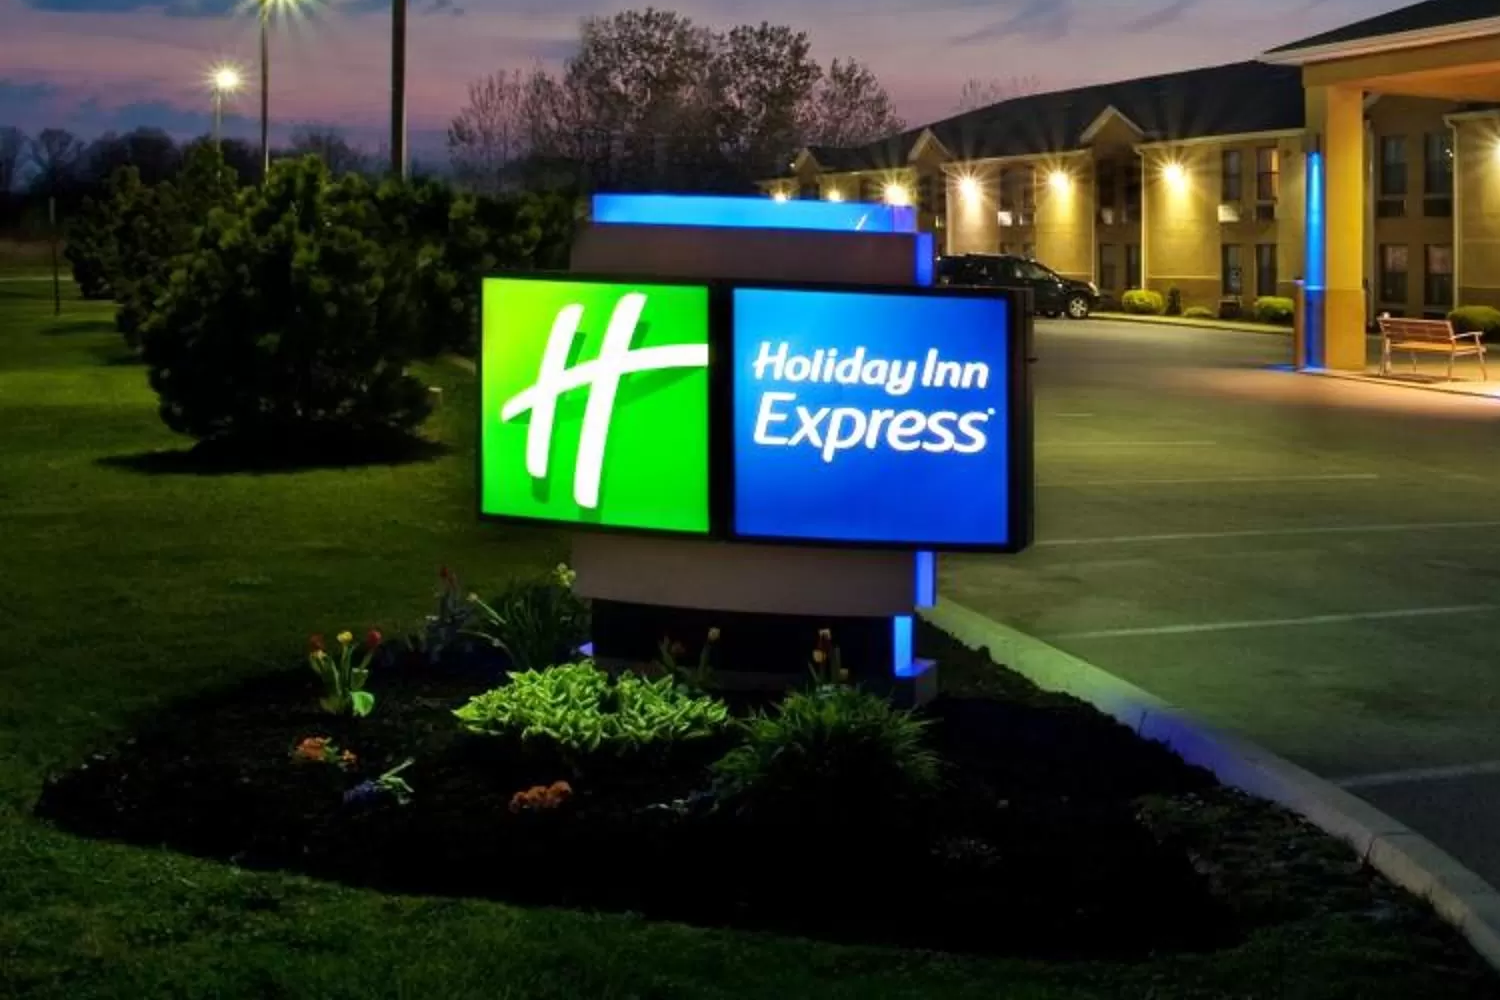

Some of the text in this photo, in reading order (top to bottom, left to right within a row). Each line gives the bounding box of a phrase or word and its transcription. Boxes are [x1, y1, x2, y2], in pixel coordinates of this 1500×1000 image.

[501, 292, 708, 509] H
[752, 341, 989, 395] Holiday Inn
[753, 391, 990, 462] Express
